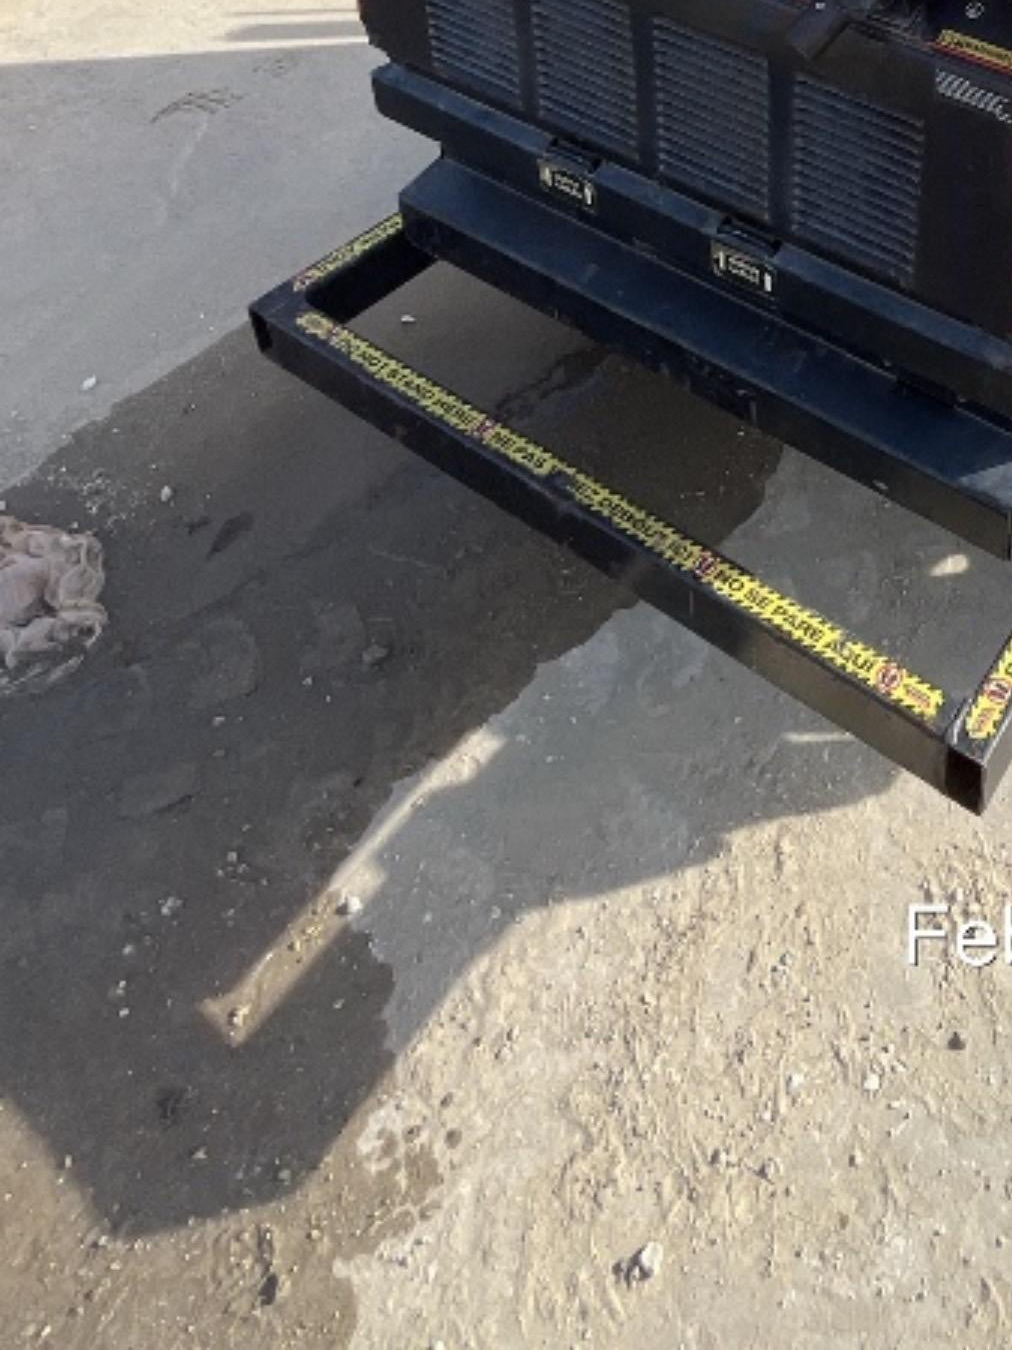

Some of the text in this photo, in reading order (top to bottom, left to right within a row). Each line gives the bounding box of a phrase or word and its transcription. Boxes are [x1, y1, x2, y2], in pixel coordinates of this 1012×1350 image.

[714, 567, 745, 592] NO
[744, 588, 773, 610] SE
[770, 606, 825, 644] PARE
